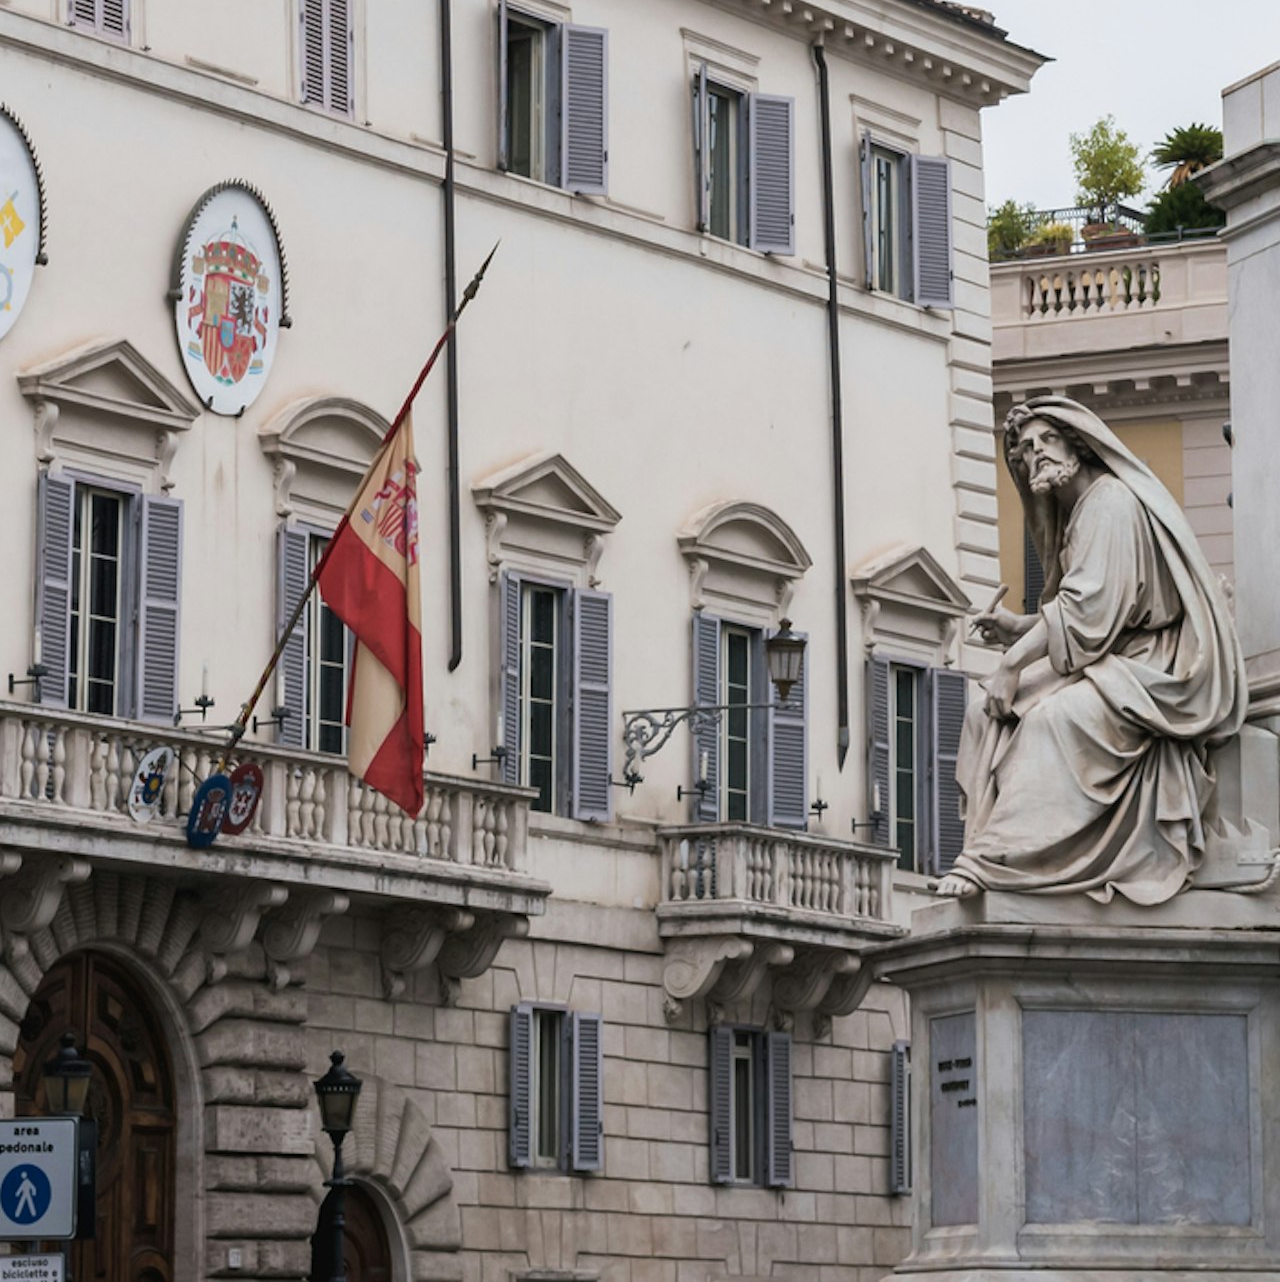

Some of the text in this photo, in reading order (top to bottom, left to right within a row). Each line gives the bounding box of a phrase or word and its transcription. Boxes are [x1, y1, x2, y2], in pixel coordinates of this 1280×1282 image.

[14, 1127, 39, 1135] area
[0, 1142, 54, 1154] pedonale
[12, 1257, 48, 1267] escluso
[3, 1269, 48, 1279] biciclette
